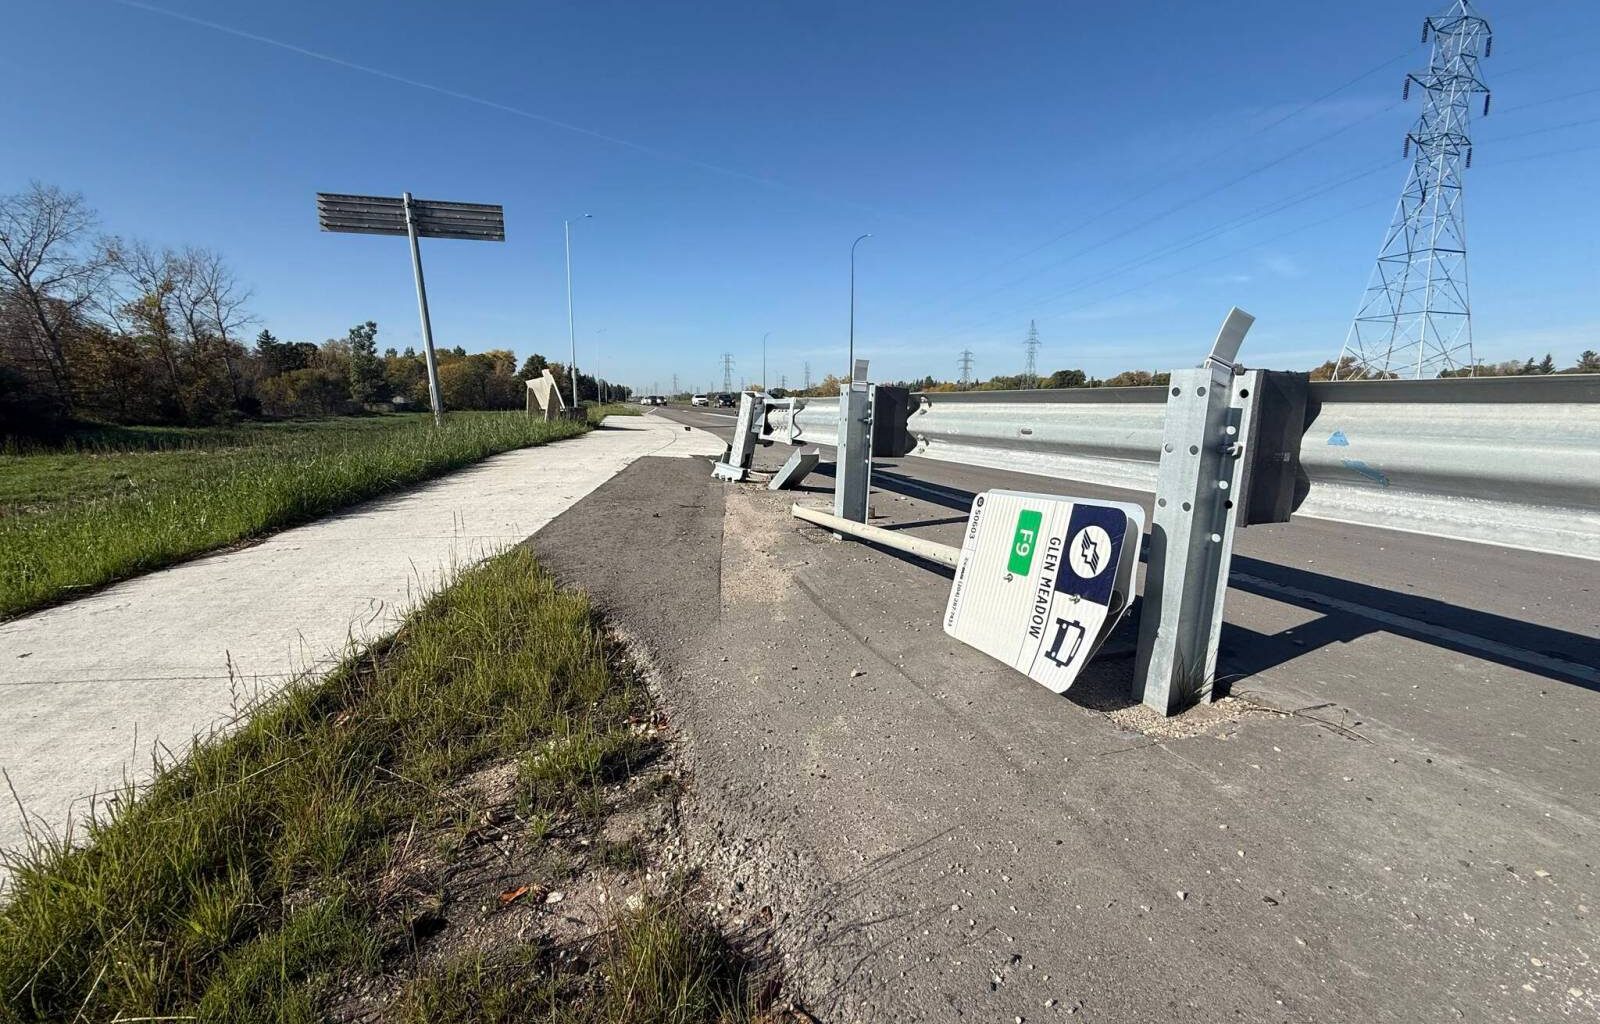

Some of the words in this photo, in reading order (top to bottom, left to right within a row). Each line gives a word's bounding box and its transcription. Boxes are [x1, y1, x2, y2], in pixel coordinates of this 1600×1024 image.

[969, 509, 981, 539] 50603
[1016, 529, 1034, 557] F9
[1043, 537, 1061, 571] GLEN
[1029, 577, 1052, 639] MEADOW
